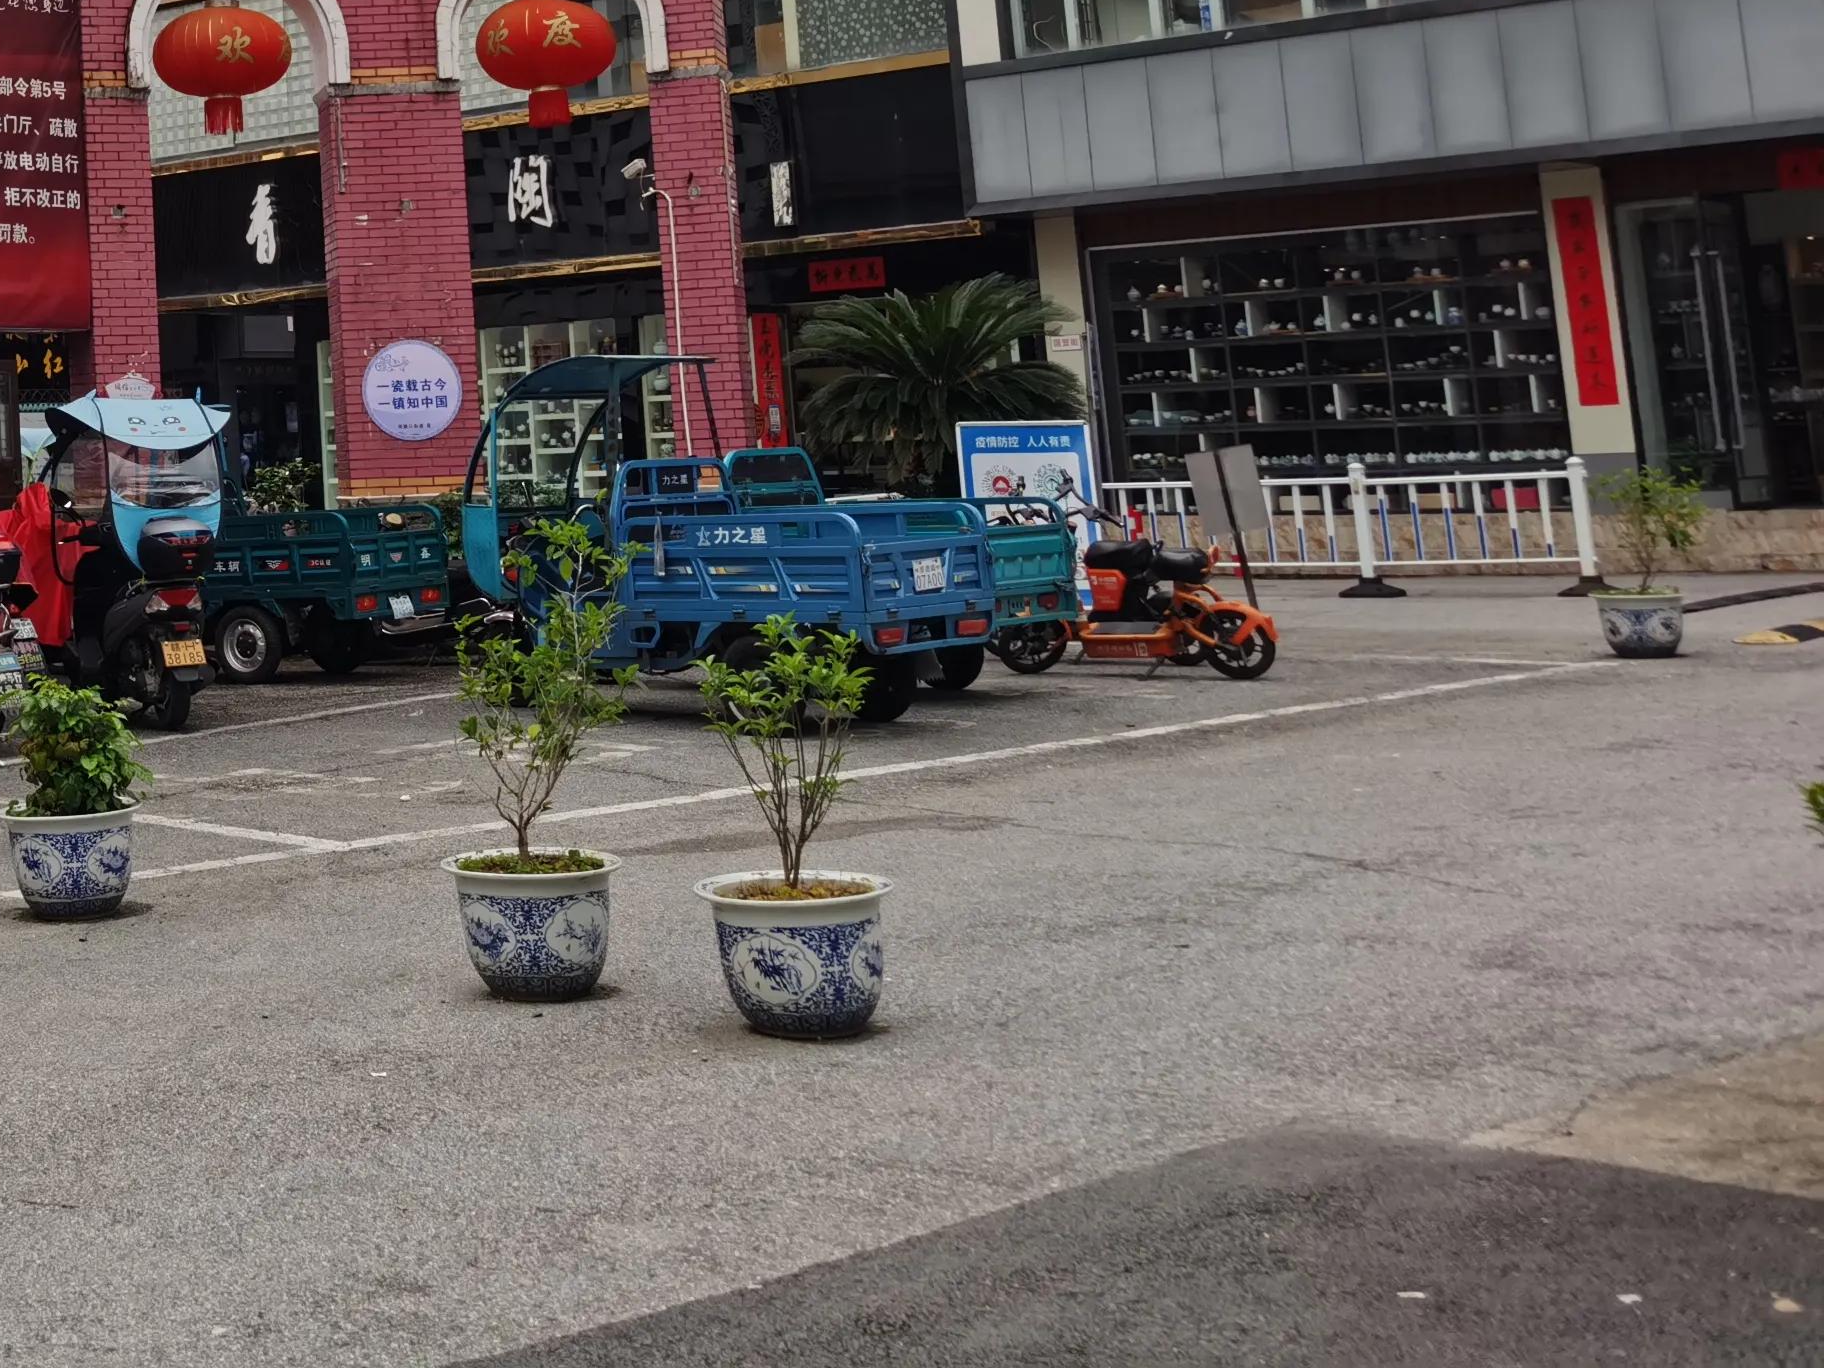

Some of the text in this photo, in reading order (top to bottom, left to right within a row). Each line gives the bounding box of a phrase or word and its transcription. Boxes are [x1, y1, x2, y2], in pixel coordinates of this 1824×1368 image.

[376, 378, 447, 392] 一瓷载古今
[378, 395, 448, 410] 一镇知中国
[976, 435, 1072, 449] 疫情防控 人人有责
[662, 474, 688, 485] 力之星
[714, 526, 768, 545] 力之星
[167, 652, 204, 666] 38185
